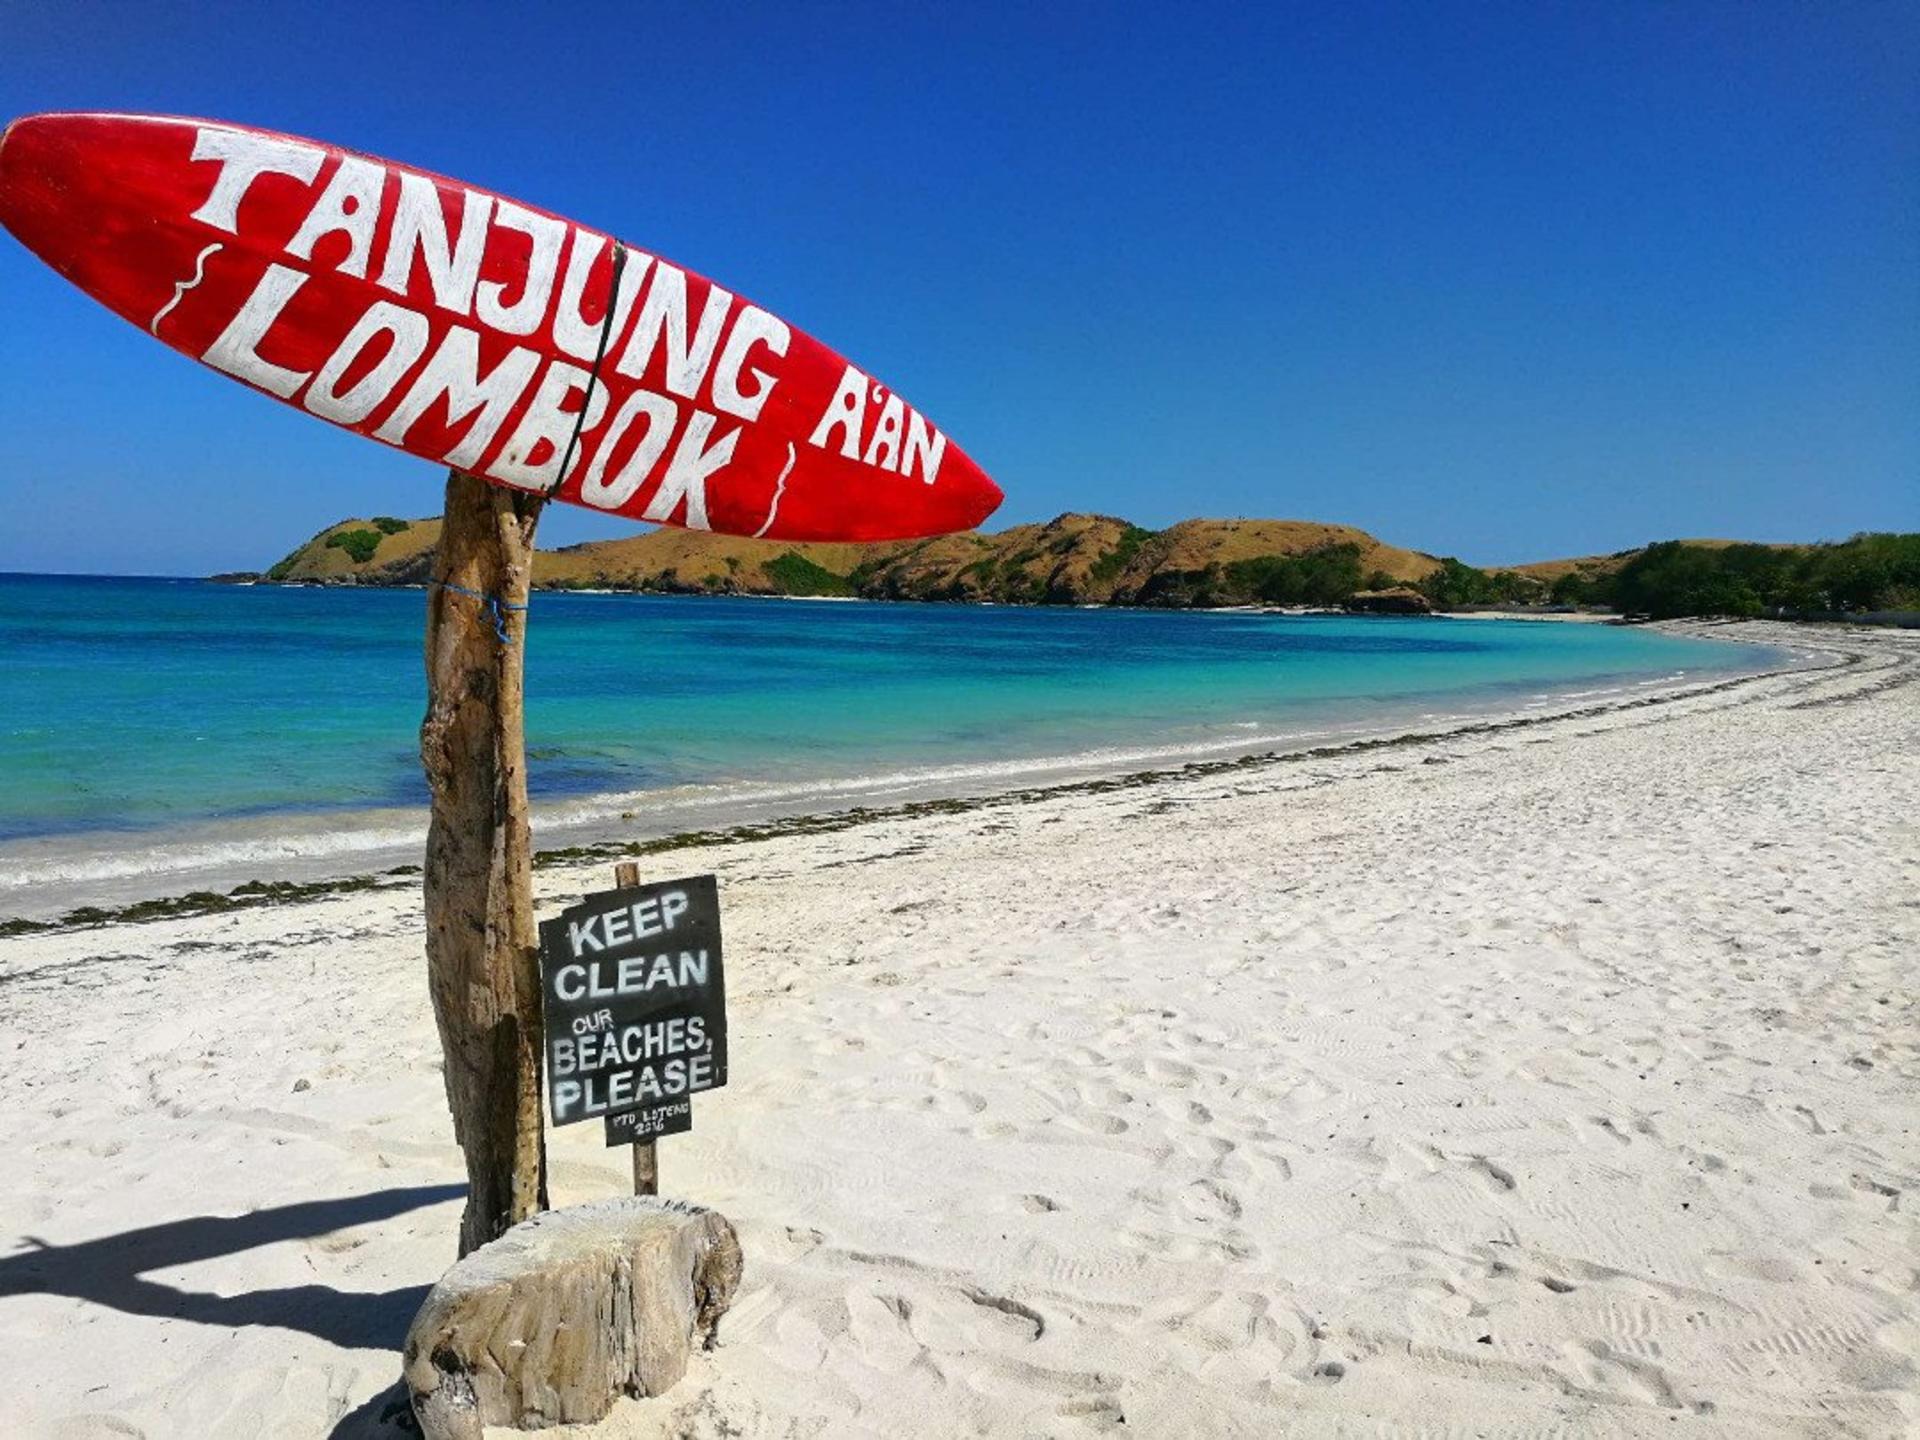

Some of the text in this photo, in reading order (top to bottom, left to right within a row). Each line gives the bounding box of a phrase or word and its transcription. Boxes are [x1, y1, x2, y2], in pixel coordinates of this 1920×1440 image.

[190, 128, 790, 421] TANJUNG
[201, 262, 742, 531] LOMBOK
[568, 891, 688, 957] KEEP
[554, 950, 708, 1001] CLEAN
[572, 1008, 614, 1035] OUR
[554, 1054, 712, 1119] PLEASE
